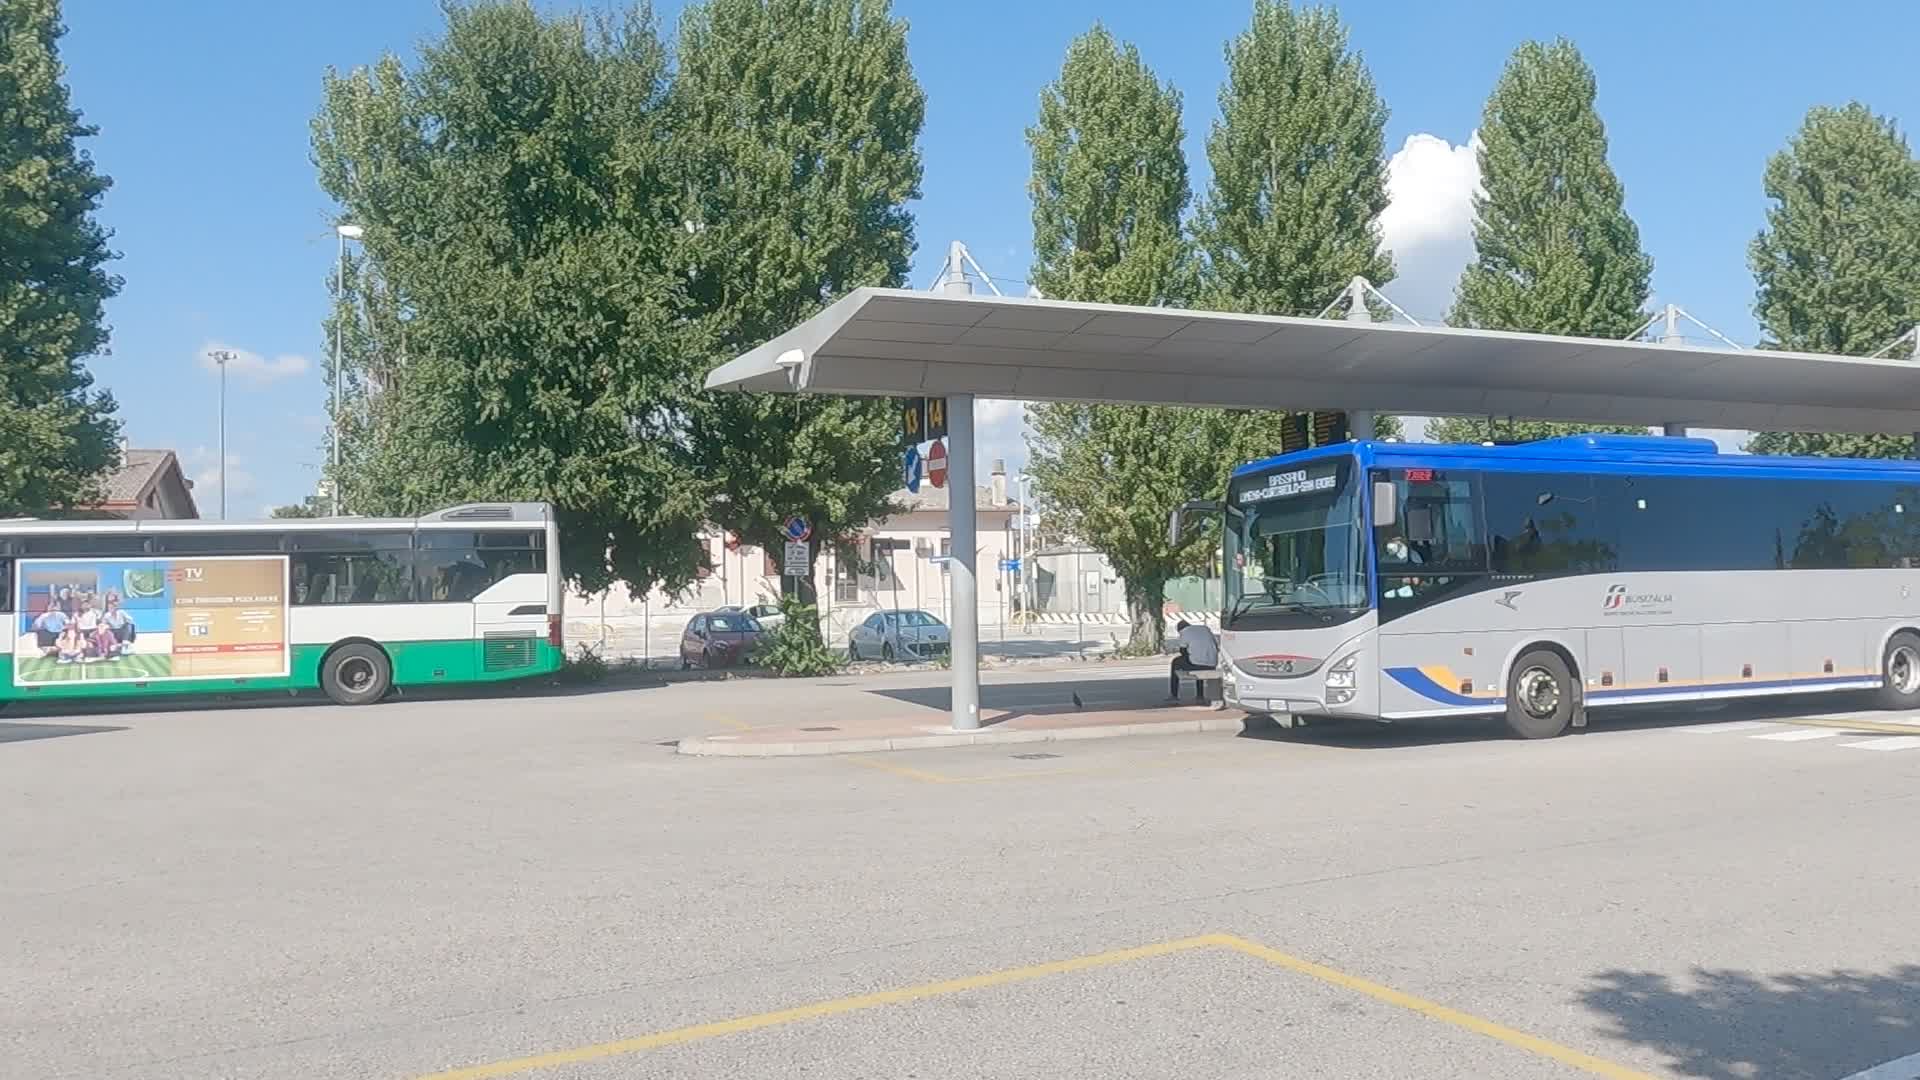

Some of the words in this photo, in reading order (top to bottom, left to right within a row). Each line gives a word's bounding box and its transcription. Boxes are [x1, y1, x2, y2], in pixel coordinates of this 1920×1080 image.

[904, 407, 919, 435] 13
[928, 399, 944, 428] 14
[184, 567, 203, 578] TV
